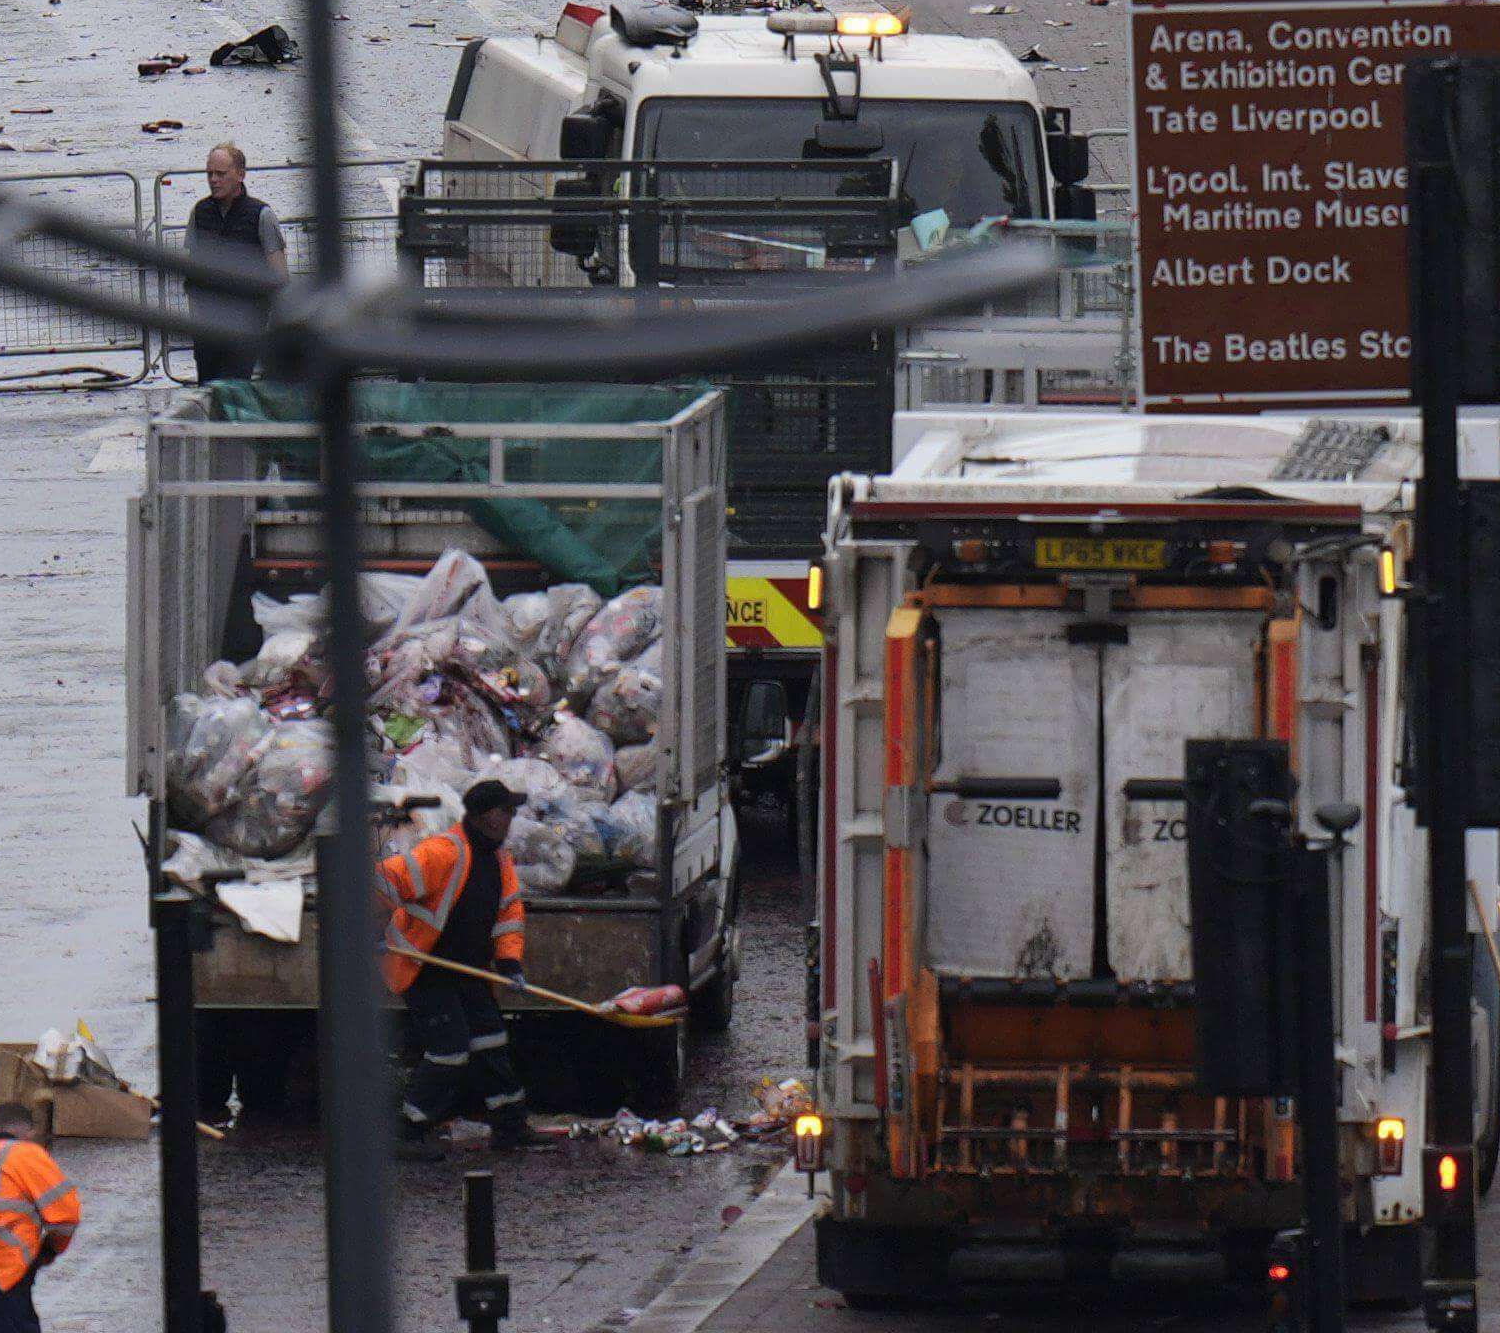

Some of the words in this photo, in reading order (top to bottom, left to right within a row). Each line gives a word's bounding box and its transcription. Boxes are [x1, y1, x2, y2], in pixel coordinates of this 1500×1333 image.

[1268, 18, 1452, 49] Convention
[1145, 61, 1168, 90] &
[1180, 56, 1338, 90] Exhibition
[1147, 104, 1218, 135] Tate
[1231, 100, 1382, 137] Liverpool
[1261, 162, 1310, 192] Int.
[1322, 160, 1408, 191] Slave
[1162, 200, 1304, 232] Maritime
[1152, 256, 1256, 287] Albert
[1267, 254, 1351, 285] Dock
[1152, 334, 1213, 365] The
[1225, 330, 1348, 363] Beatles
[1360, 329, 1411, 359] Sto
[978, 805, 1080, 834] ZOELLER
